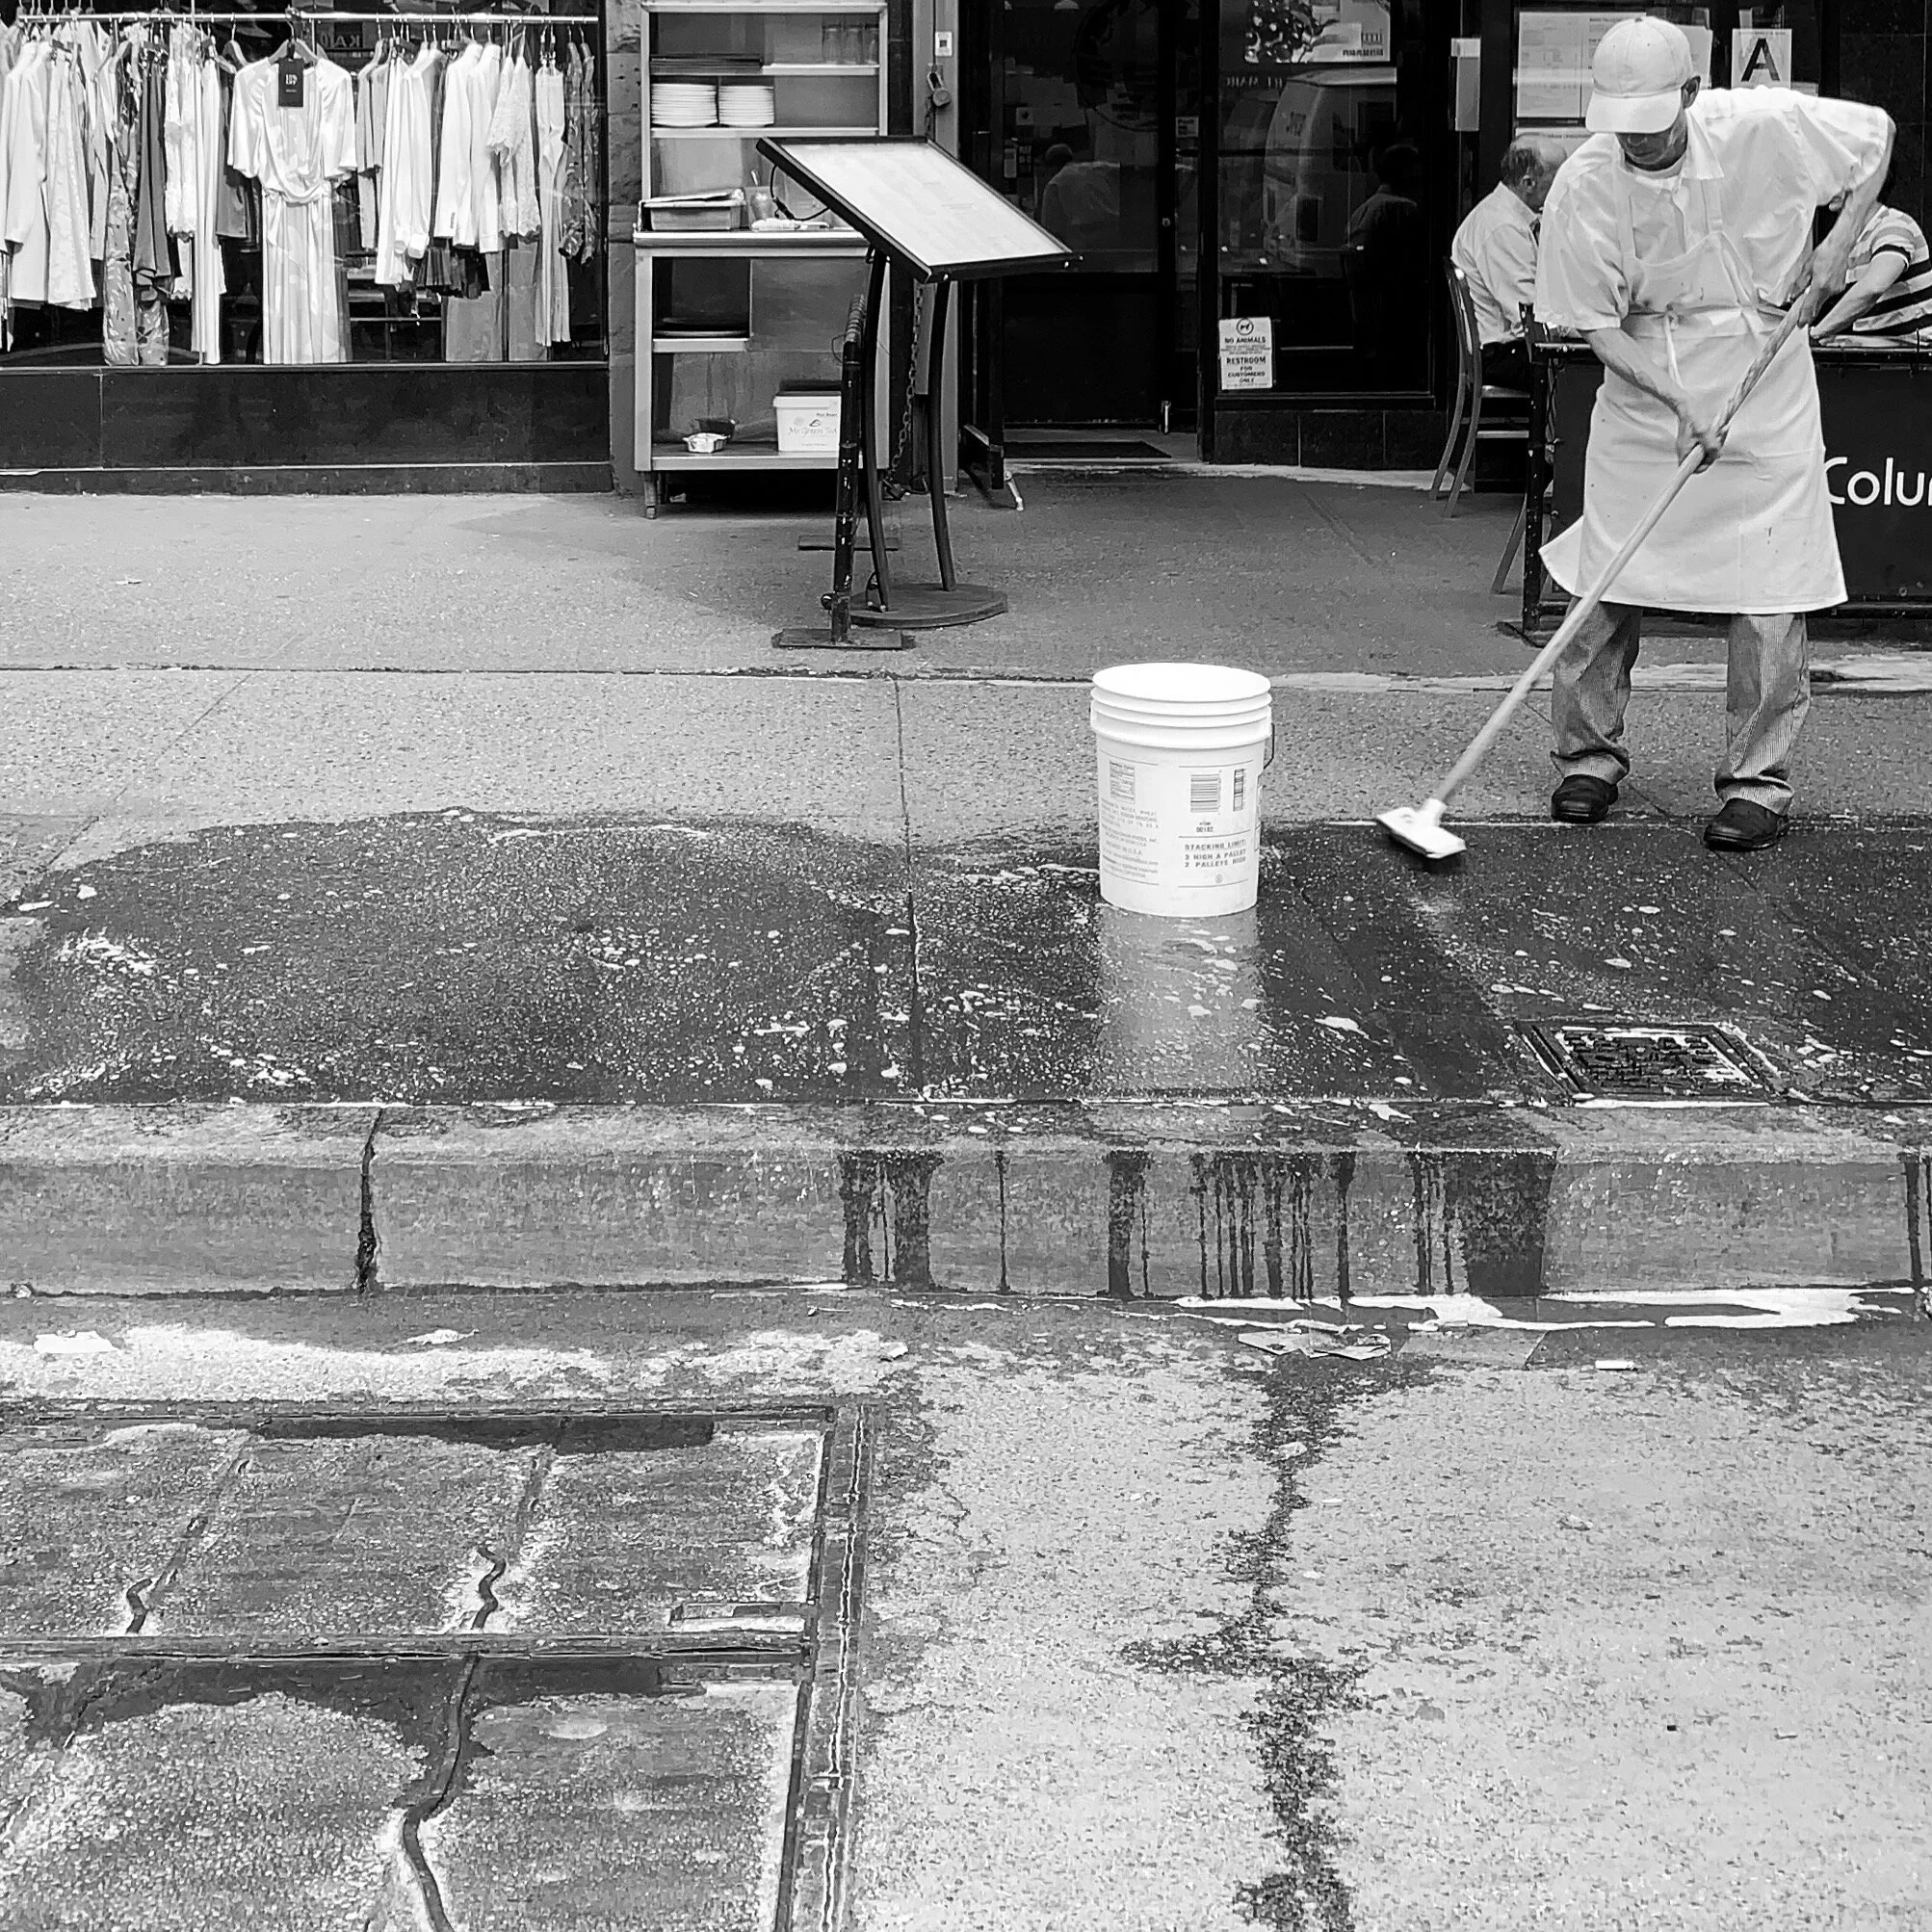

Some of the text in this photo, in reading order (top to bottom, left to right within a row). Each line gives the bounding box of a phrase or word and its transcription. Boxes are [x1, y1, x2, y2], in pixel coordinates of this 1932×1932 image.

[1740, 38, 1781, 82] A
[1824, 456, 1932, 507] Colu
[1195, 859, 1228, 868] PALLETS
[1224, 849, 1246, 859] PALLET
